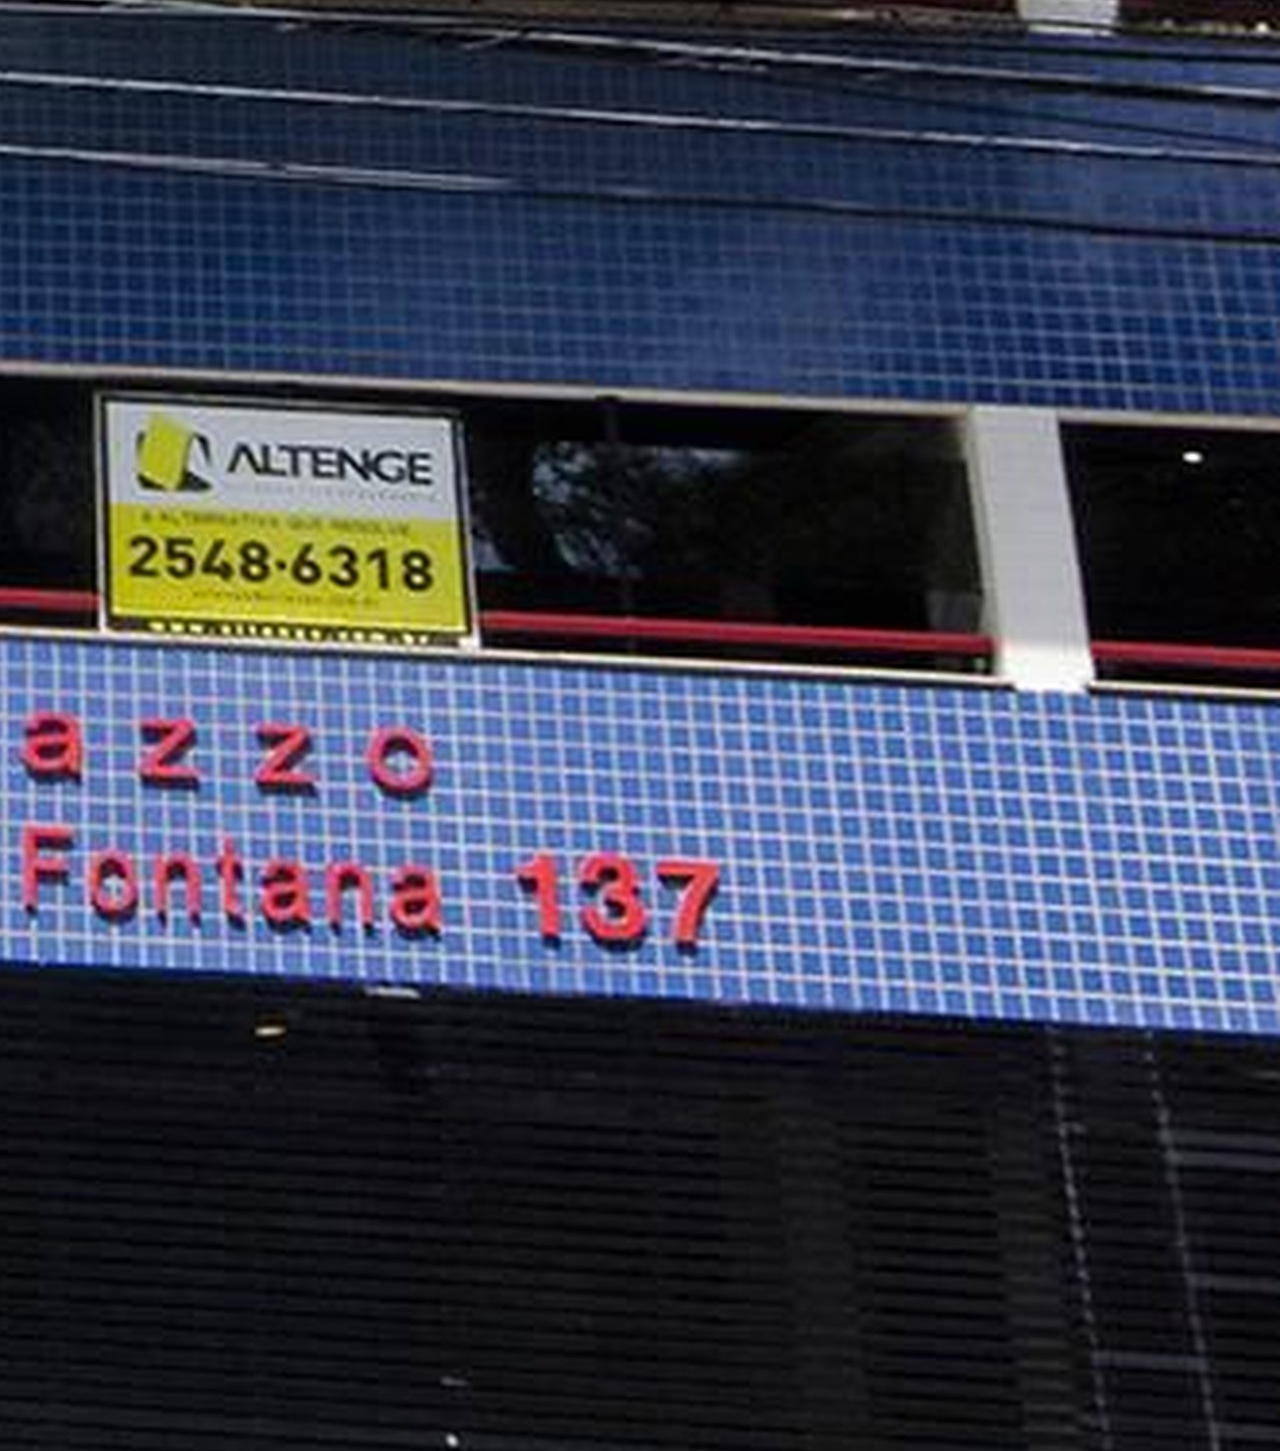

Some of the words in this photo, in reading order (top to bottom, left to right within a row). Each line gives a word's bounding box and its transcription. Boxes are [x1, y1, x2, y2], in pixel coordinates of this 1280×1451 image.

[226, 442, 434, 486] ALTENGE
[21, 825, 442, 933] Fontana
[516, 852, 722, 948] 137
